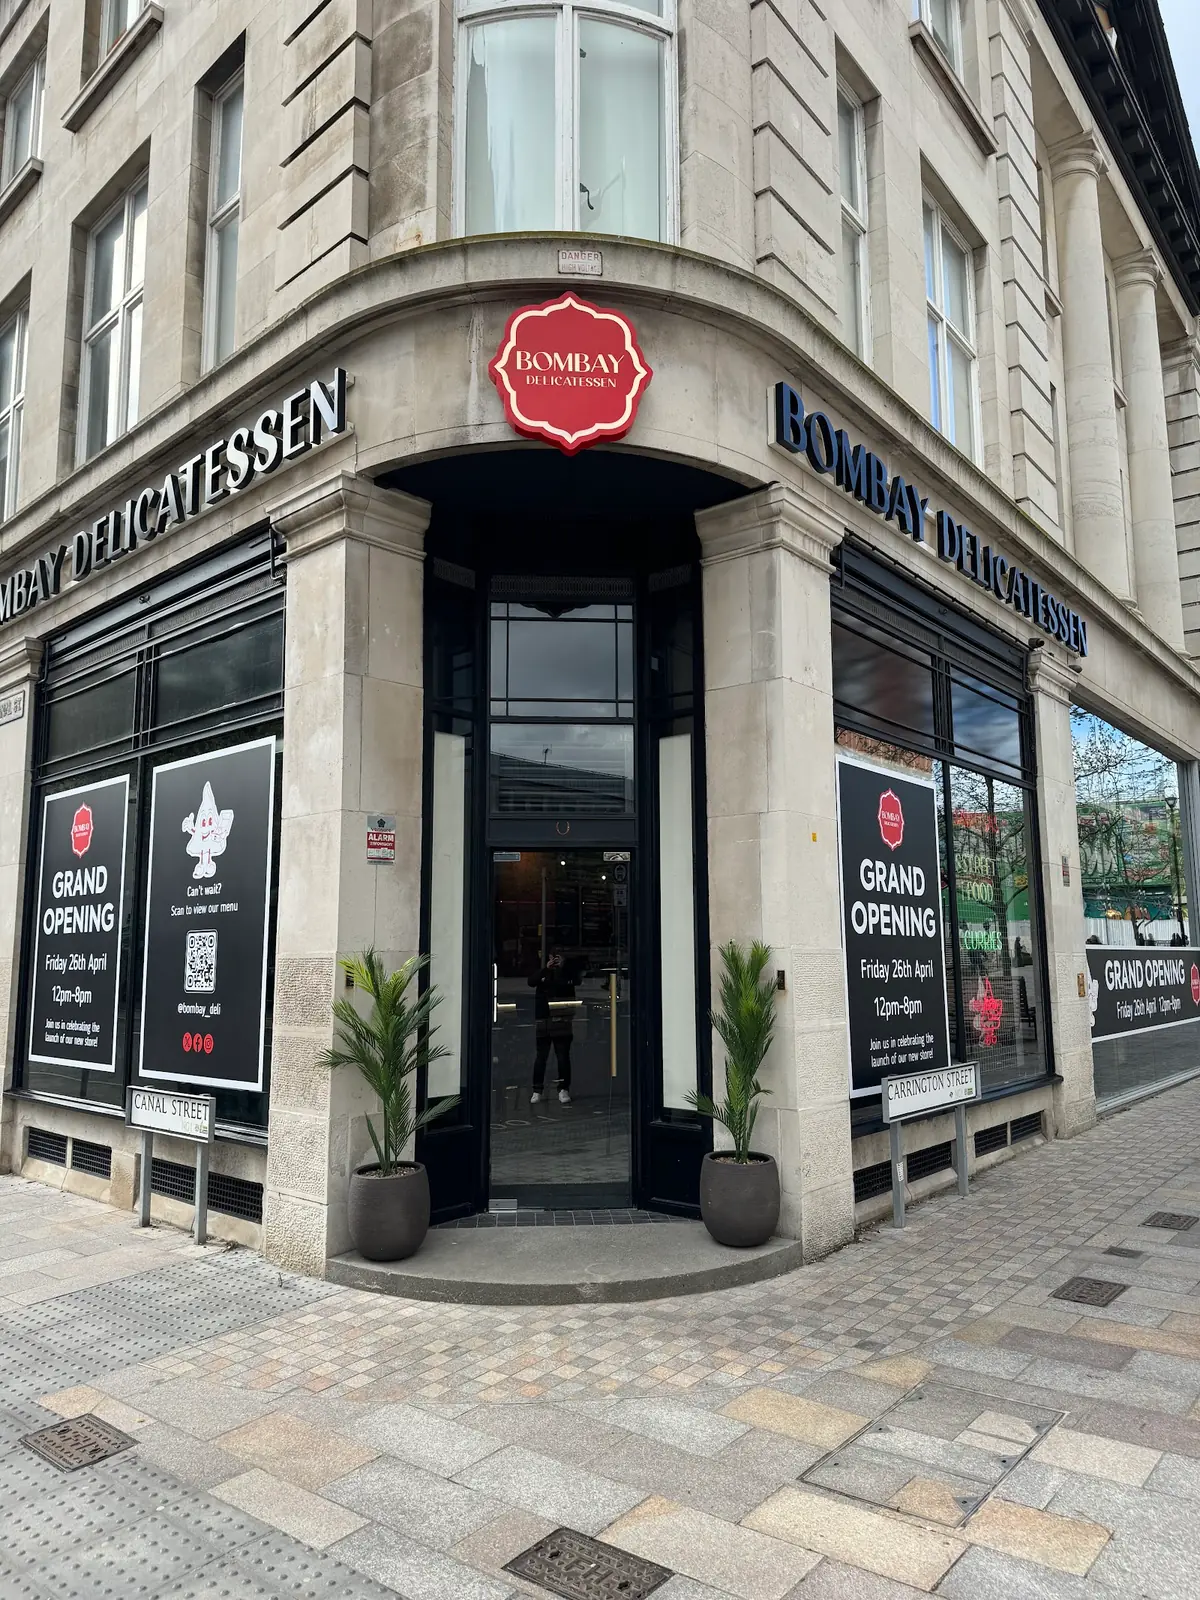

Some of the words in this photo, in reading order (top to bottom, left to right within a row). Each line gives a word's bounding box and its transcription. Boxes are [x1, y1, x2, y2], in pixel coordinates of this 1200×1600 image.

[561, 251, 600, 261] DANGER
[516, 351, 625, 374] BOMBAY
[526, 375, 617, 388] DELICATESSEN
[72, 367, 347, 582] DELICATESSEN
[775, 381, 929, 543] BOMBAY
[936, 510, 1089, 658] DELICATESSEN
[368, 833, 394, 842] ALARM
[52, 865, 108, 899] GRAND
[860, 858, 925, 897] GRAND
[187, 885, 203, 897] Can't
[204, 883, 222, 896] wait?
[43, 902, 115, 935] OPENING
[170, 905, 185, 917] Scan
[186, 905, 193, 915] to
[193, 903, 207, 914] view
[207, 904, 219, 913] our
[220, 902, 239, 912] menu
[851, 901, 936, 939] OPENING
[964, 929, 1003, 951] CURRIES
[45, 954, 68, 975] Friday
[68, 953, 86, 971] 26th
[87, 953, 107, 975] April
[861, 959, 889, 983] Friday
[892, 959, 912, 978] 26th
[914, 959, 934, 983] April
[1105, 959, 1144, 990] GRAND
[1144, 959, 1186, 988] OPENING
[51, 985, 92, 1008] 12pm-8pm
[177, 1003, 221, 1018] @bombay_deli
[874, 996, 922, 1021] 12pm-8pm
[1116, 1001, 1133, 1022] Friday
[1133, 999, 1145, 1016] 26th
[1145, 997, 1157, 1018] April
[1158, 995, 1181, 1016] 12pm-8pm
[45, 1018, 54, 1029] Join
[55, 1021, 61, 1029] us
[61, 1019, 66, 1030] in
[66, 1020, 91, 1035] celebrating
[91, 1022, 100, 1033] the
[45, 1032, 59, 1043] launch
[60, 1034, 65, 1043] of
[65, 1036, 73, 1045] our
[74, 1037, 83, 1046] new
[84, 1037, 98, 1047] store!
[870, 1038, 881, 1051] Join
[882, 1039, 890, 1049] us
[890, 1036, 896, 1048] in
[897, 1033, 925, 1048] celebrating
[925, 1032, 934, 1044] the
[871, 1052, 890, 1068] launch
[890, 1052, 897, 1065] of
[898, 1053, 908, 1064] our
[908, 1052, 919, 1062] new
[919, 1048, 934, 1060] store!
[887, 1074, 944, 1101] CARRINGTON
[946, 1068, 973, 1088] STREET
[134, 1093, 167, 1114] CANAL
[171, 1100, 209, 1121] STREET
